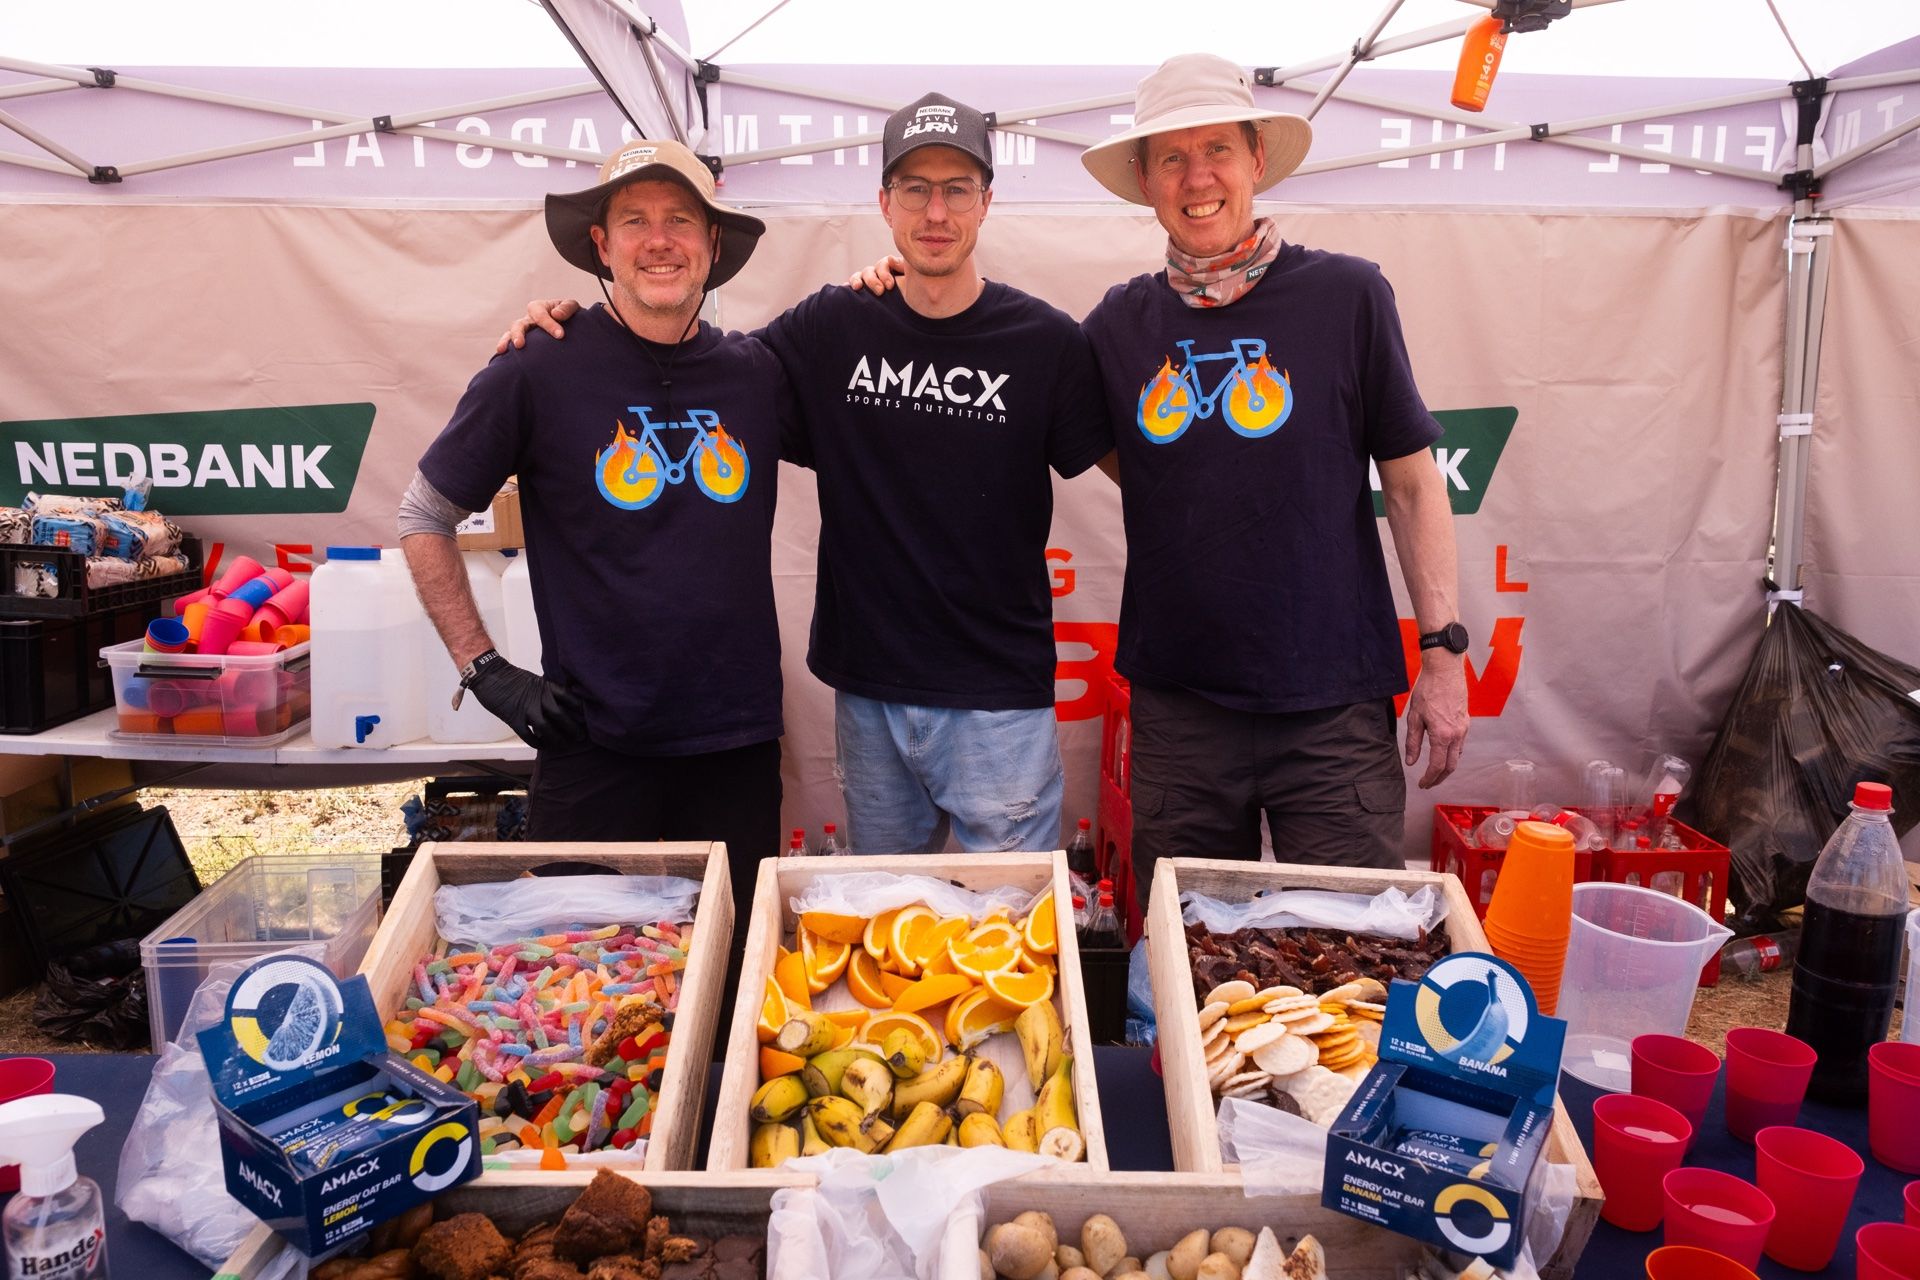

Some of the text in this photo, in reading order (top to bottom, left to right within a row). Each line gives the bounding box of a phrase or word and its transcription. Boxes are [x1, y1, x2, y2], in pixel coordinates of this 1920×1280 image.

[906, 115, 959, 127] GRAVEL
[919, 107, 952, 115] NEDBANK
[903, 121, 959, 140] BURN
[848, 355, 1010, 411] AMACX
[846, 394, 901, 409] SPORTS
[14, 441, 336, 490] NEDBANK
[1391, 1037, 1400, 1046] 12
[302, 1043, 341, 1067] LEMON
[1458, 1055, 1508, 1078] BANANA
[1344, 1150, 1406, 1180] AMACX
[1396, 1142, 1451, 1165] AMACX
[239, 1160, 283, 1209] AMACX
[320, 1157, 381, 1196] AMACX
[322, 1173, 402, 1218] ENERGY OAT BAR
[1342, 1183, 1383, 1203] BANANA
[1343, 1173, 1426, 1208] ENERGY OAT BAR
[323, 1203, 359, 1227] LEMON
